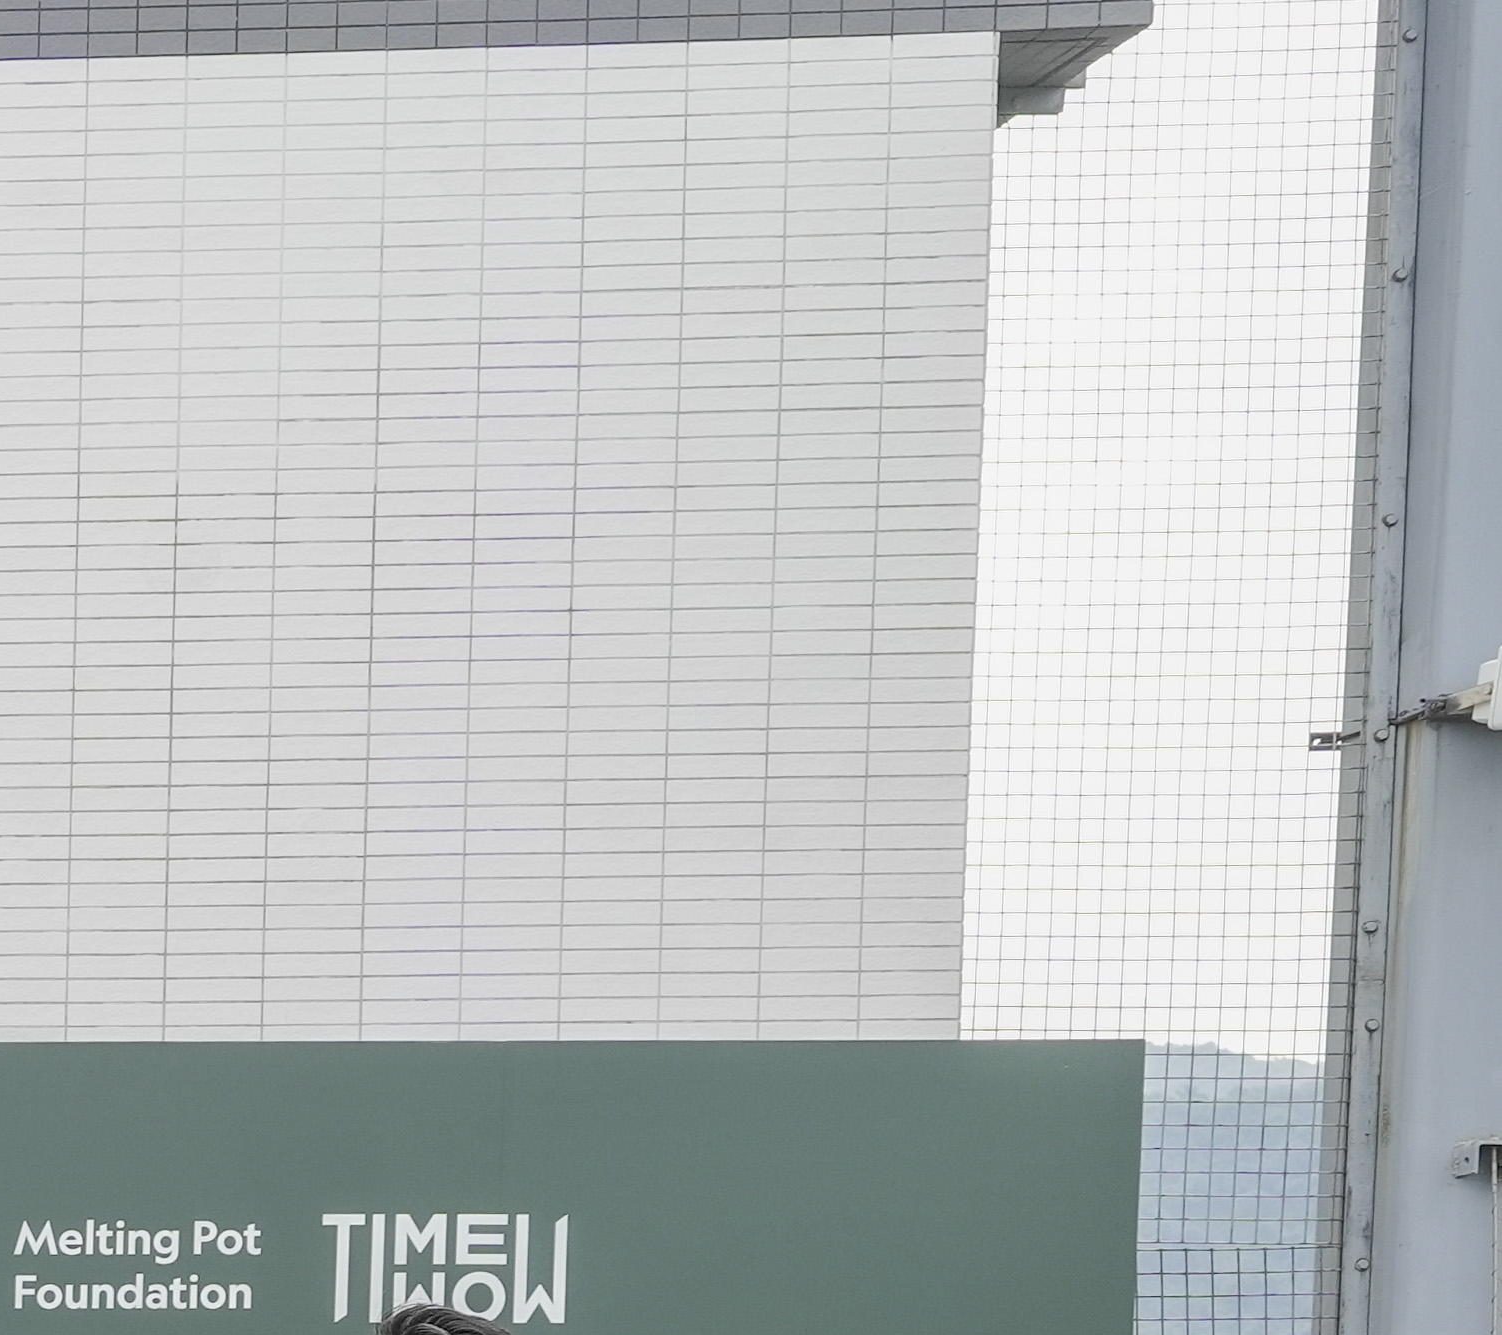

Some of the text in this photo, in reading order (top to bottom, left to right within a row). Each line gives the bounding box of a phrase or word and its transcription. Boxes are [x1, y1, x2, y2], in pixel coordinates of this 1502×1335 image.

[14, 1219, 262, 1265] Melting Pot
[14, 1273, 253, 1310] Foundation
